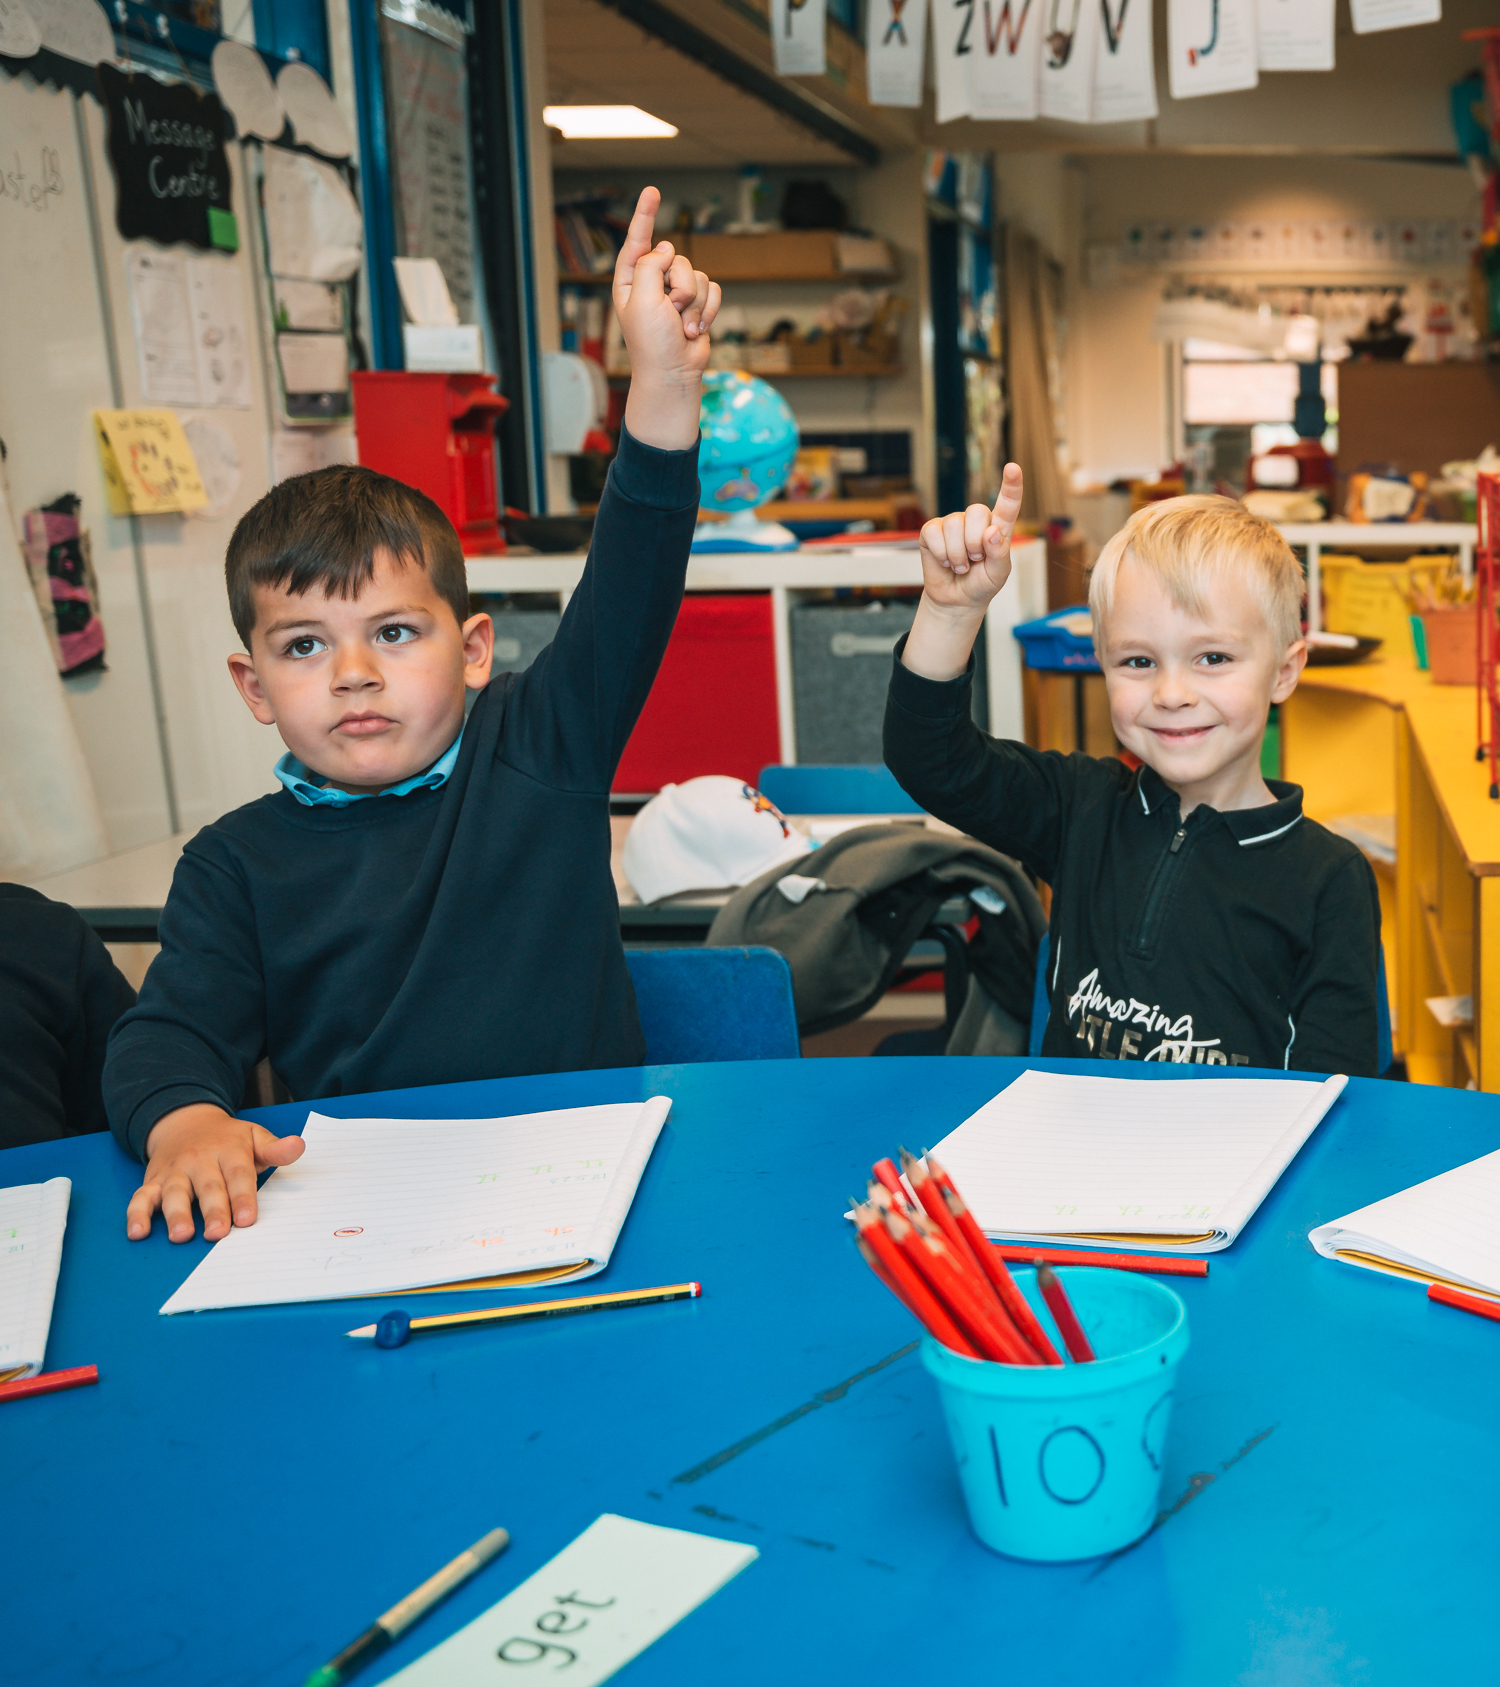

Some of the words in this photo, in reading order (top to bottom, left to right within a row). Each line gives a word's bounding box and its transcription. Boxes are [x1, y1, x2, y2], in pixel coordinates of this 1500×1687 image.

[122, 95, 217, 170] Message
[148, 155, 219, 200] Centre
[1069, 967, 1221, 1061] Amazing
[551, 1304, 594, 1315] STAEDTLER
[496, 1589, 618, 1671] get
